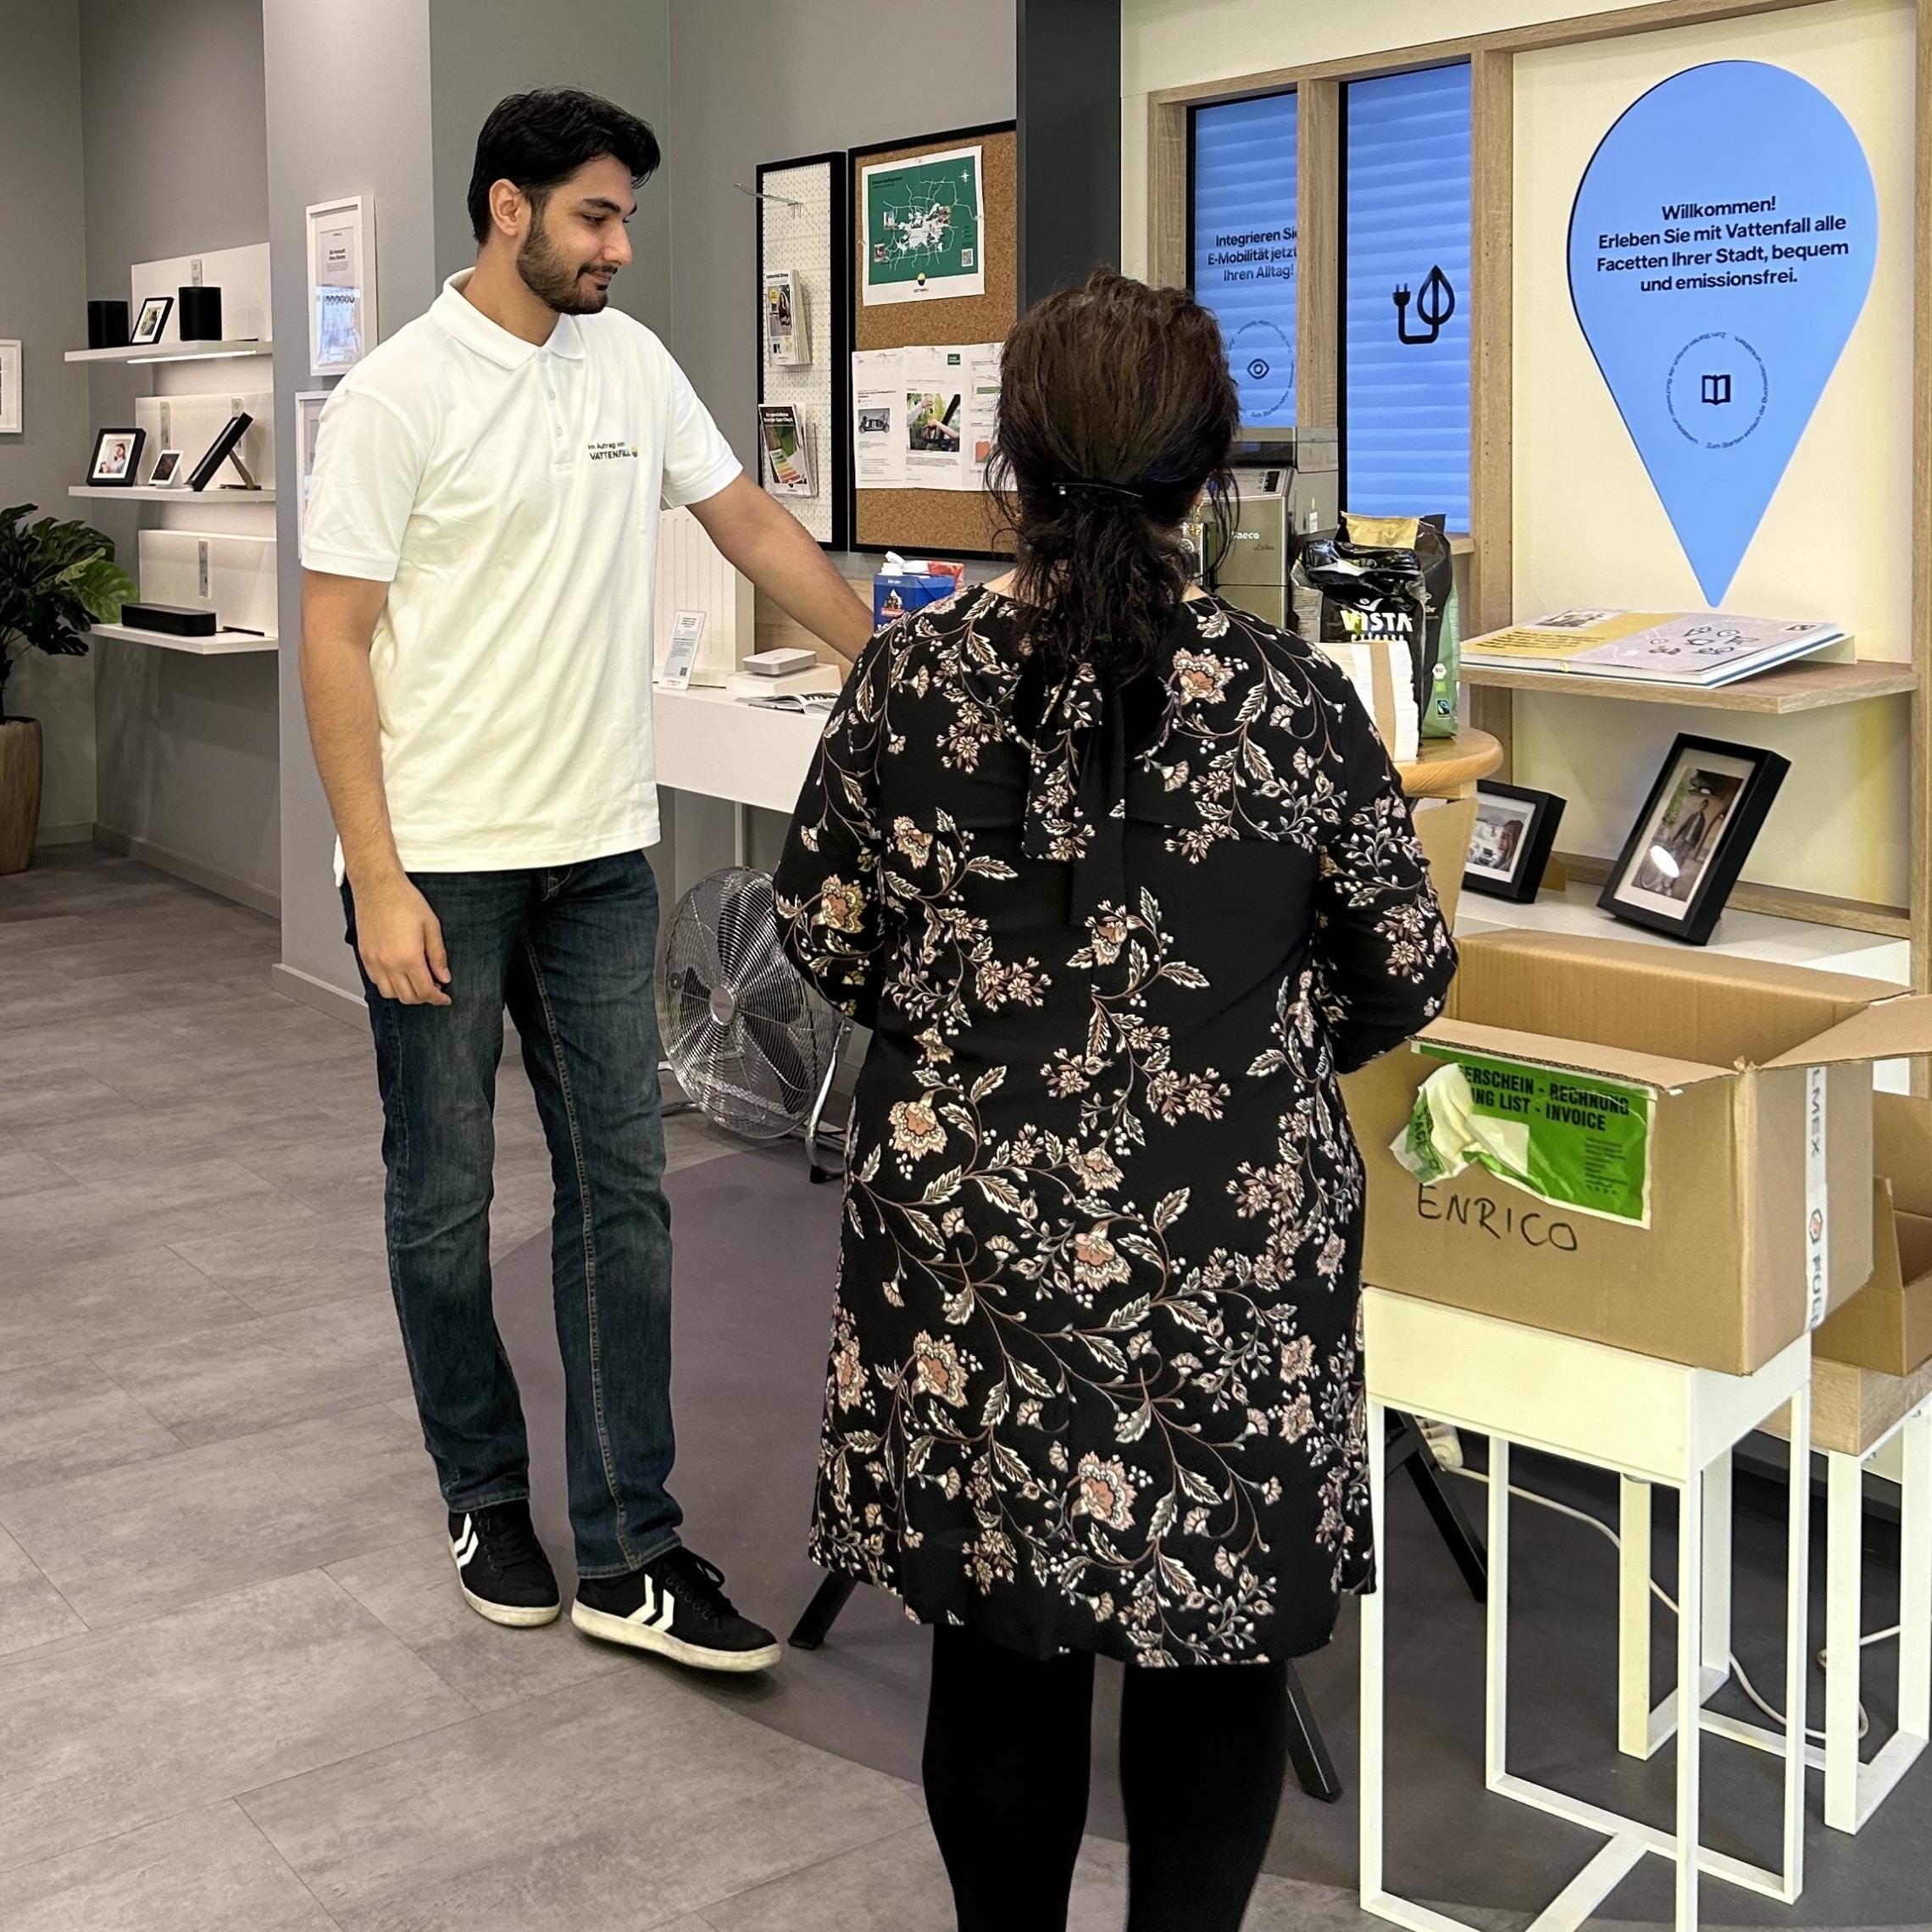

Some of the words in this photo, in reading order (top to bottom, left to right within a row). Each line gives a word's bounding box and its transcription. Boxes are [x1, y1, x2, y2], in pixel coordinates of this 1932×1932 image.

[1662, 196, 1776, 220] Willkommen!
[1216, 230, 1280, 247] Integrieren
[1599, 233, 1660, 249] Erleben
[1663, 227, 1690, 243] Sie
[1694, 224, 1722, 241] mit
[1726, 217, 1811, 239] Vattenfall
[1814, 214, 1846, 231] alle
[1208, 248, 1269, 265] E-Mobilität
[1271, 246, 1297, 263] jetzt
[1597, 255, 1668, 272] Facetten
[1672, 251, 1713, 267] Ihrer
[1715, 245, 1768, 264] Stadt,
[1772, 242, 1849, 262] bequem
[1224, 269, 1254, 281] Ihren
[1256, 263, 1294, 280] Alltag!
[1641, 276, 1672, 292] und
[1675, 267, 1798, 289] emissionsfrei.
[590, 450, 630, 460] VATTENFALL
[1340, 610, 1413, 632] VISTA
[1458, 1064, 1534, 1095] ERSCHEIN
[1549, 1082, 1629, 1116] RECHNUNG
[1471, 1086, 1495, 1108] ING
[1500, 1092, 1531, 1114] LIST
[1546, 1102, 1607, 1132] INVOICE
[1418, 1182, 1578, 1252] ENRICO
